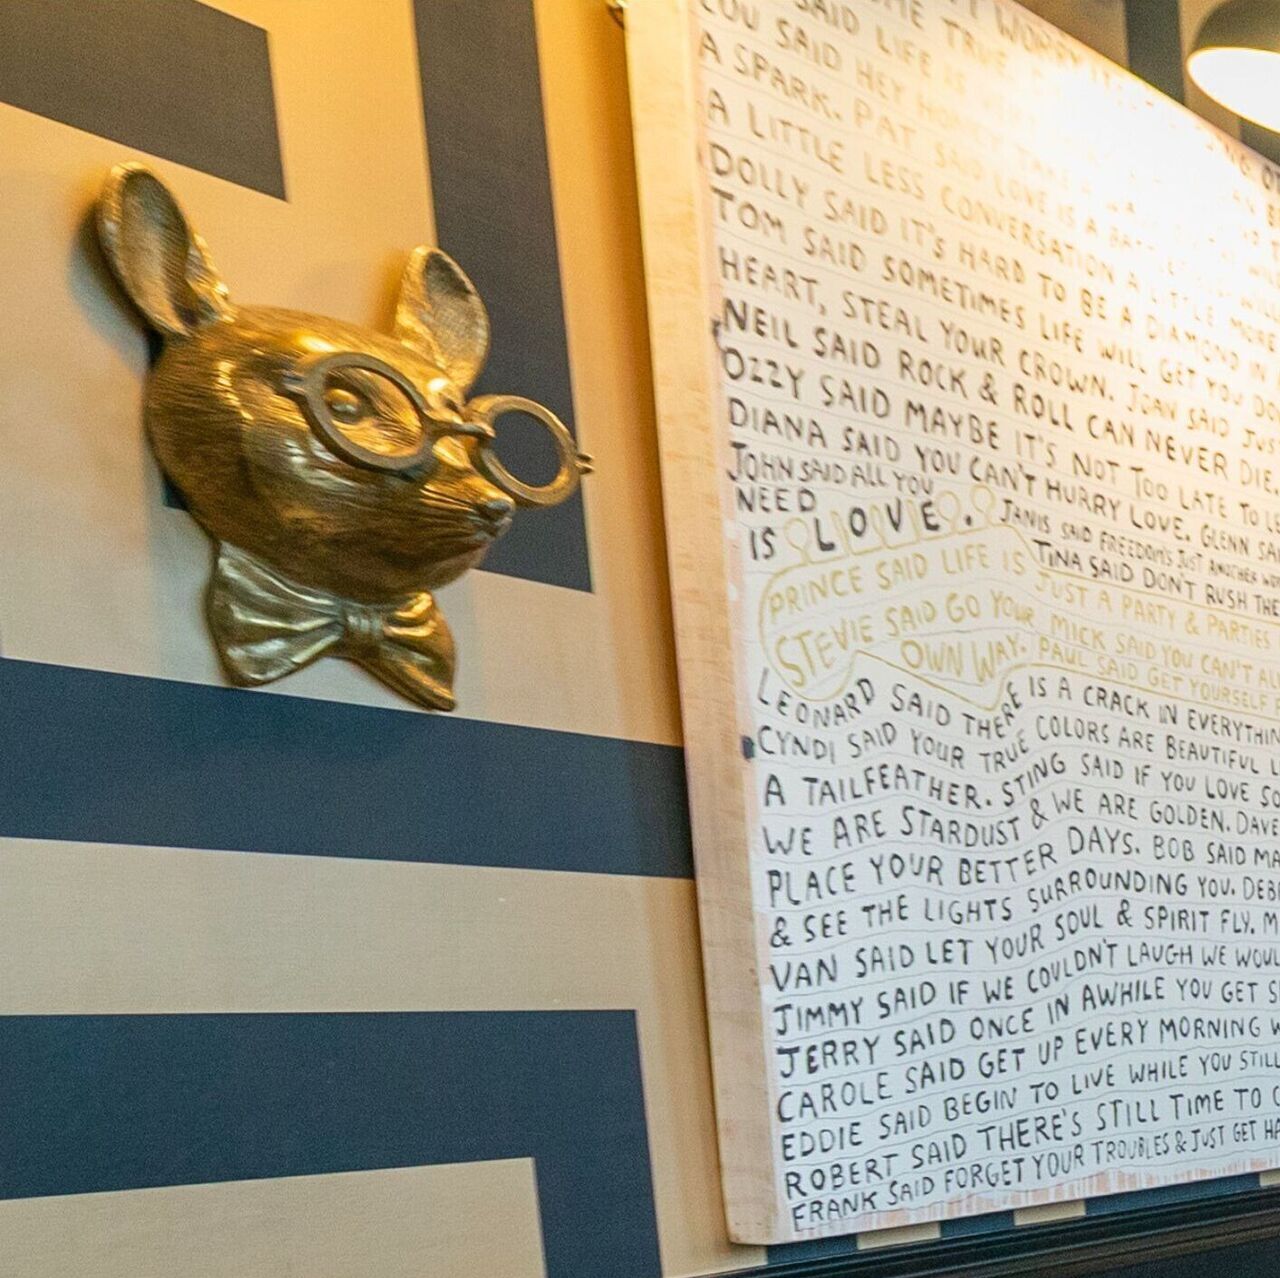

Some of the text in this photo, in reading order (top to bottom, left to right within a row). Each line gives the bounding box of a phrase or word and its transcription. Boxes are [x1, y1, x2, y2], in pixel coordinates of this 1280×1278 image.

[717, 246, 1113, 401] HEART, STEAL YOUR CROWN.
[723, 297, 798, 349] NEIL
[813, 325, 880, 369] SAID
[898, 348, 967, 397] ROCK
[1013, 382, 1073, 431] ROLL
[1086, 413, 1134, 446] CAN
[1146, 428, 1226, 475] NEVER
[1239, 458, 1279, 496] DIE.
[728, 396, 1190, 542] DIANA SAID YOU CAN'T HURRY LOVE.
[735, 484, 817, 514] NEED
[749, 526, 775, 560] IS
[766, 567, 864, 624] PRINCE
[876, 551, 929, 591] SAID
[939, 544, 990, 575] LIFE
[758, 667, 876, 727] LEONARD
[891, 685, 951, 727] SAID
[962, 681, 1025, 740] THERE
[1028, 675, 1047, 698] IS
[1082, 684, 1149, 718] CRACK
[759, 725, 835, 762] CYNDI
[846, 720, 897, 759] SAID
[910, 729, 964, 768] YOUR
[978, 735, 1030, 774] TRUE
[1036, 714, 1109, 744] COLORS
[1118, 726, 1154, 752] ARE
[1165, 733, 1259, 775] BEAUTIFUL
[775, 1036, 879, 1078] JERRY
[893, 1017, 955, 1057] SAID
[969, 1006, 1033, 1040] ONCE
[1047, 994, 1069, 1024] IN
[1081, 975, 1164, 1011] AWHILE
[1175, 977, 1212, 999] YOU
[1220, 980, 1258, 1003] GET
[775, 1071, 891, 1123] CAROLE
[905, 1057, 965, 1094] SAID
[977, 1046, 1025, 1079] GET
[1038, 1035, 1064, 1066] UP
[1074, 1018, 1148, 1055] EVERY
[1159, 1015, 1260, 1042] MORNING
[780, 1121, 862, 1162] EDDIE
[878, 1103, 929, 1140] SAID
[942, 1086, 1017, 1121] BEGIN
[1028, 1080, 1059, 1104] TO
[1071, 1063, 1115, 1095] LIVE
[1128, 1054, 1188, 1084] WHILE
[1198, 1051, 1232, 1075] YOU
[784, 1152, 898, 1198] ROBERT
[911, 1132, 967, 1169] SAID
[976, 1108, 1082, 1151] THERE'S
[1096, 1098, 1159, 1131] STILL
[1168, 1089, 1223, 1119] TIME
[1232, 1086, 1261, 1109] TO
